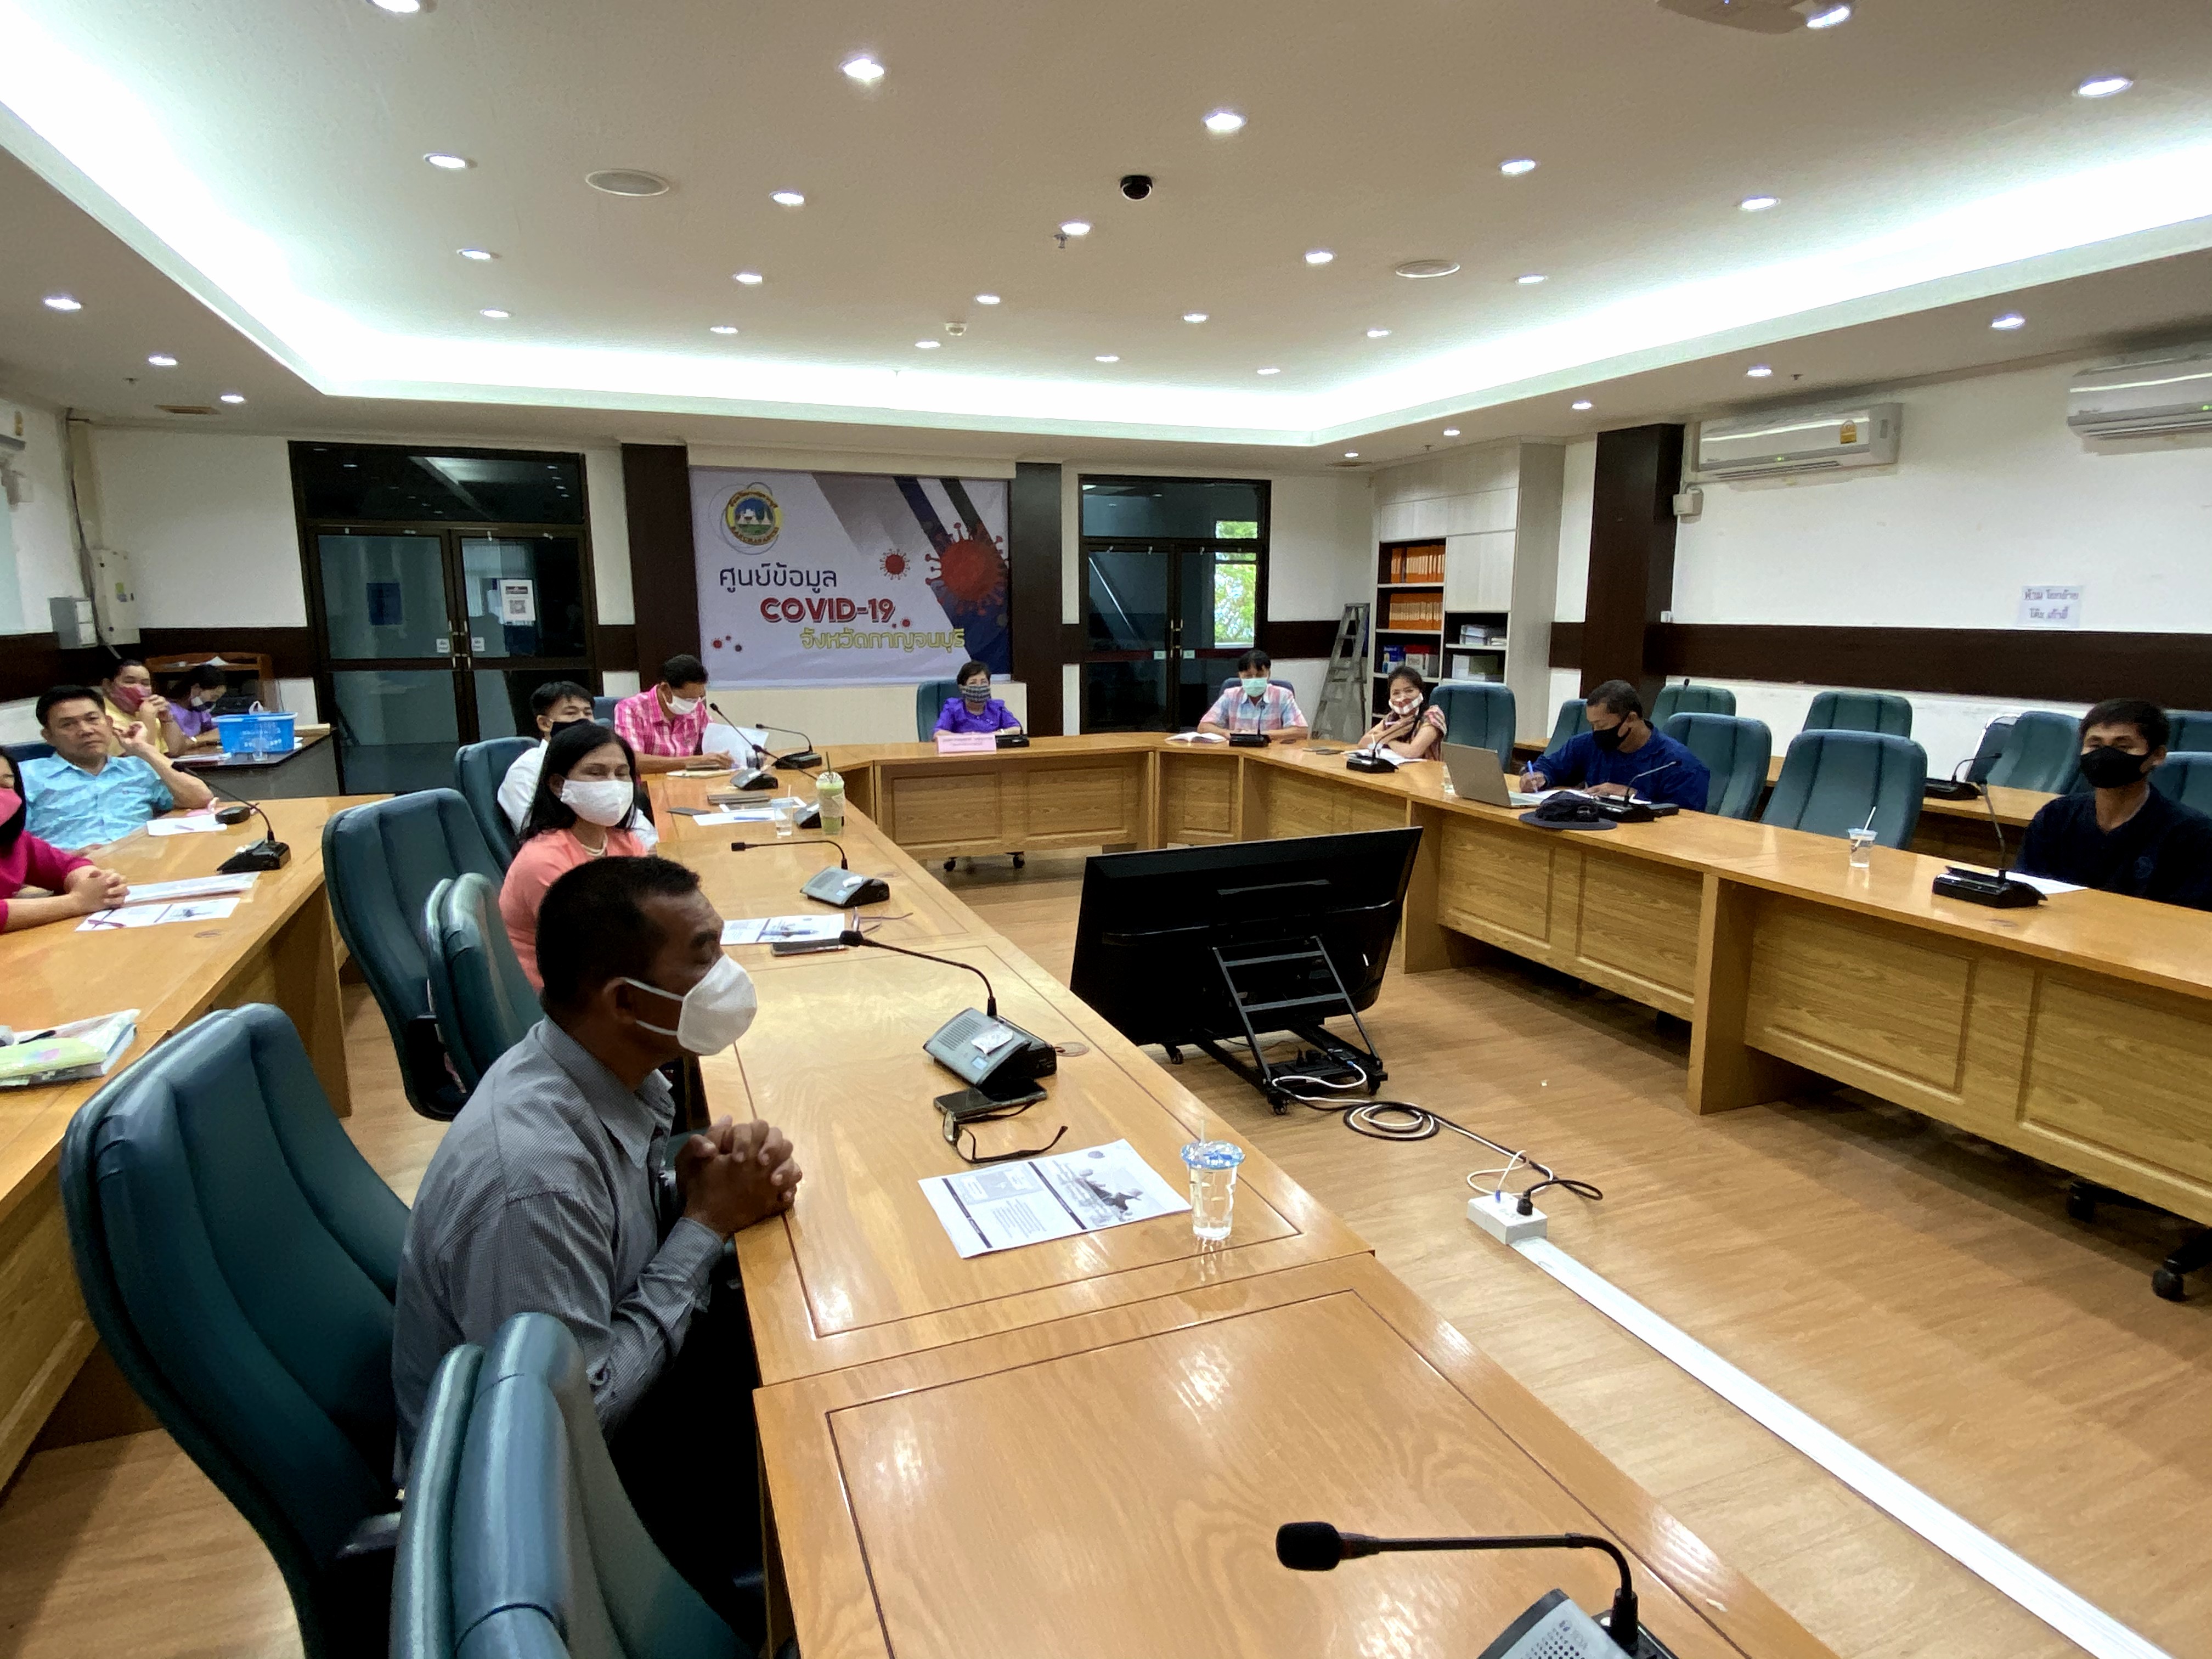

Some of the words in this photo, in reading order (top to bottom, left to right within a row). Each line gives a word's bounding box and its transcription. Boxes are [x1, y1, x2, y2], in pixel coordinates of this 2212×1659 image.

[719, 562, 837, 594] ศูนย์ข้อมูล
[760, 597, 895, 623] COVID-19
[799, 627, 965, 653] จังหวัดกาญจนบุรี
